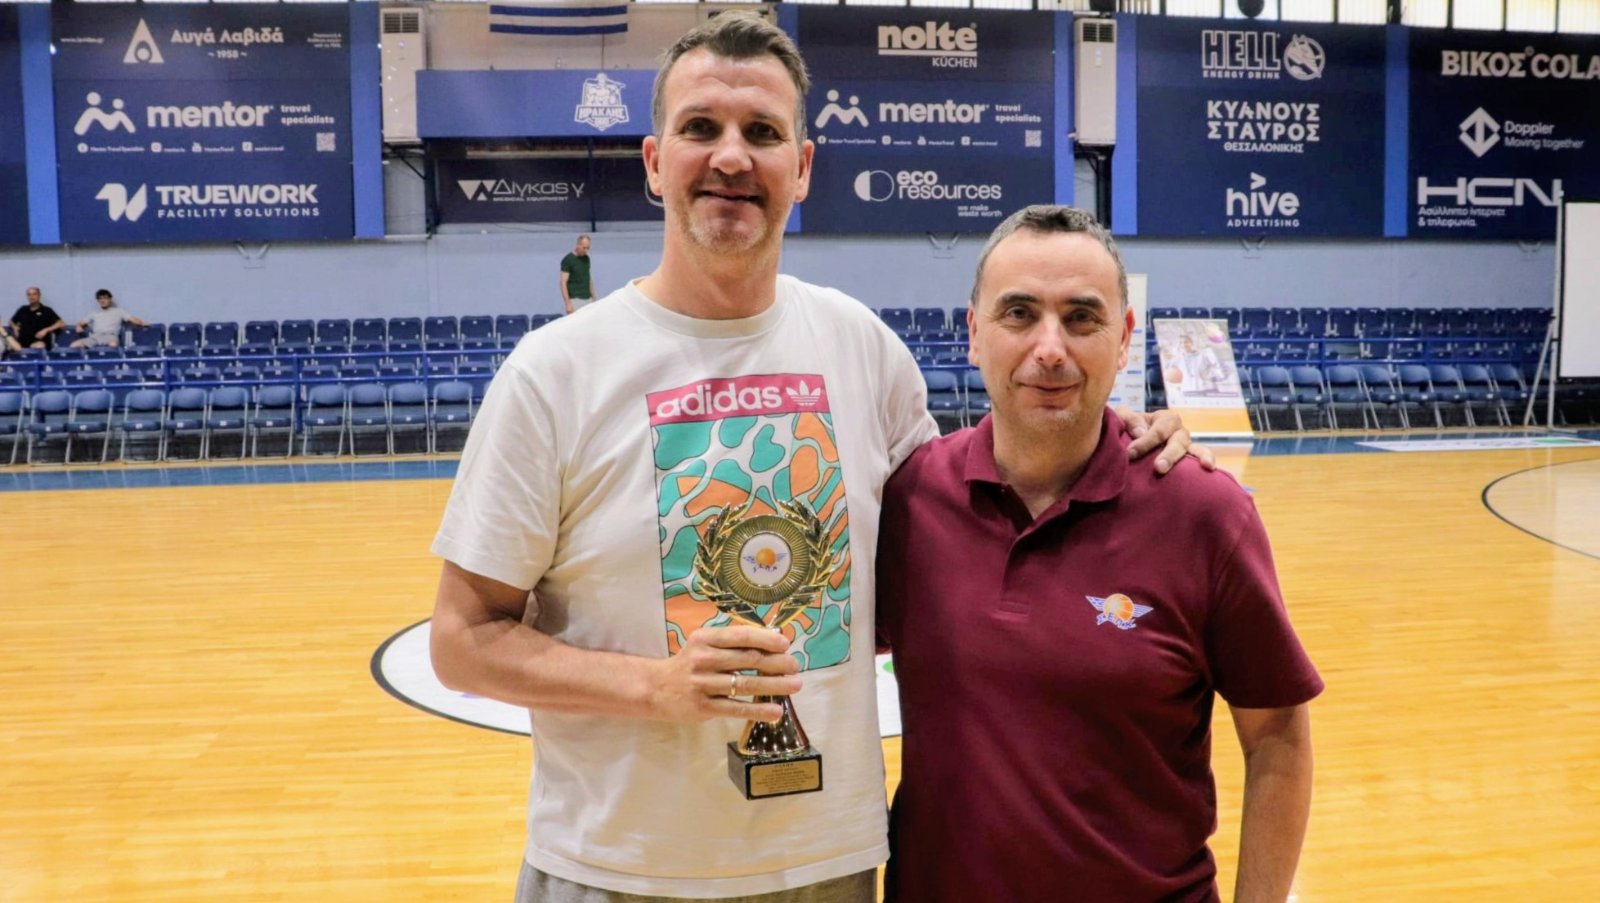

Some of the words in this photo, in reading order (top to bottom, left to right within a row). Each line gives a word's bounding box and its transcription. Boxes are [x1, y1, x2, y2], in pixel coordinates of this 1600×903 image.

[170, 27, 216, 46] Αυγά
[219, 27, 284, 46] Λαβιδά
[878, 21, 978, 51] nolte
[1202, 30, 1281, 70] HELL
[932, 57, 978, 69] KÜCHEN
[1441, 50, 1526, 77] ΒΙΚΟΣ
[1530, 53, 1600, 80] COLA
[1203, 70, 1245, 79] ENERGY
[1247, 71, 1281, 80] DRINK
[147, 101, 269, 127] mentor
[280, 104, 311, 113] travel
[879, 100, 985, 124] mentor
[995, 104, 1021, 112] travel
[1207, 100, 1320, 122] ΚΥΑΝΟΥΣ
[280, 115, 335, 126] specialists
[995, 114, 1041, 124] specialists
[1207, 121, 1320, 141] ΣΤΑΥΡΟΣ
[1504, 120, 1555, 136] Doppler
[1223, 142, 1304, 153] ΘΕΣΣΑΛΟΝΙΚΗΣ
[1504, 137, 1541, 149] Moving
[1543, 138, 1585, 150] together
[896, 170, 937, 185] eco
[155, 184, 318, 205] TRUEWORK
[899, 183, 1002, 200] resources
[1226, 172, 1300, 216] hive
[1418, 177, 1562, 206] HCN
[157, 208, 227, 218] FACILITY
[234, 207, 320, 217] SOLUTIONS
[1226, 219, 1300, 228] ADVERTISING
[1418, 217, 1426, 226] &
[656, 383, 782, 418] adidas
